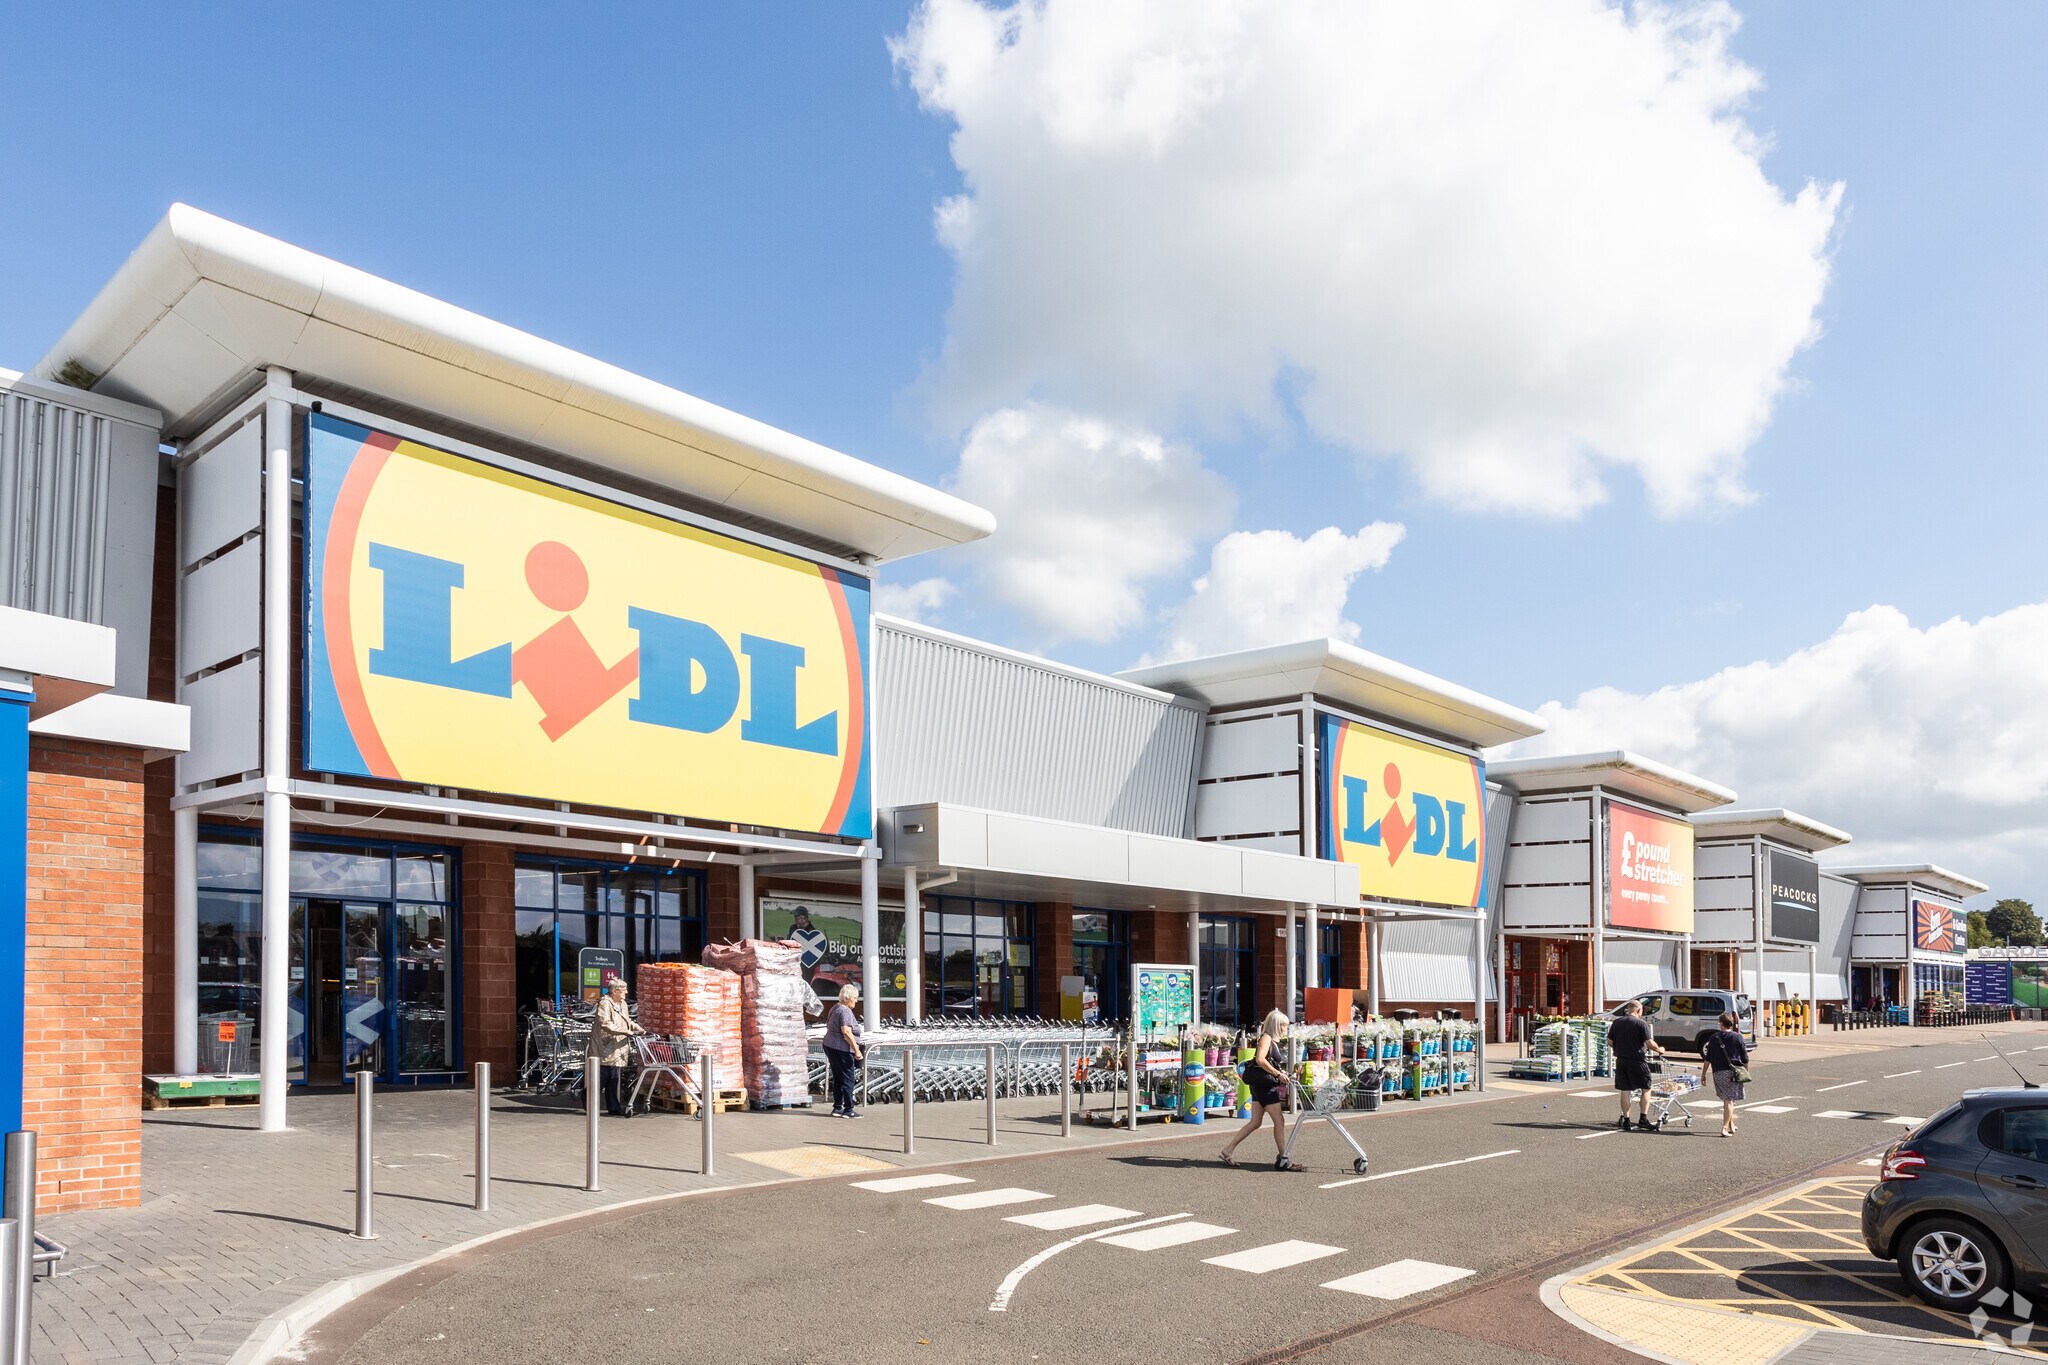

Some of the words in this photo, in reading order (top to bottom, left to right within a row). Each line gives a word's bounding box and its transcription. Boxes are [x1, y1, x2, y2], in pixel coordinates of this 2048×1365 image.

[1636, 841, 1670, 864] pound
[1634, 860, 1684, 888] stretcher
[1772, 884, 1817, 904] PEACOCKS
[829, 941, 847, 957] Big
[850, 944, 863, 955] on
[879, 943, 906, 957] ottish
[1977, 946, 2048, 957] GARDE
